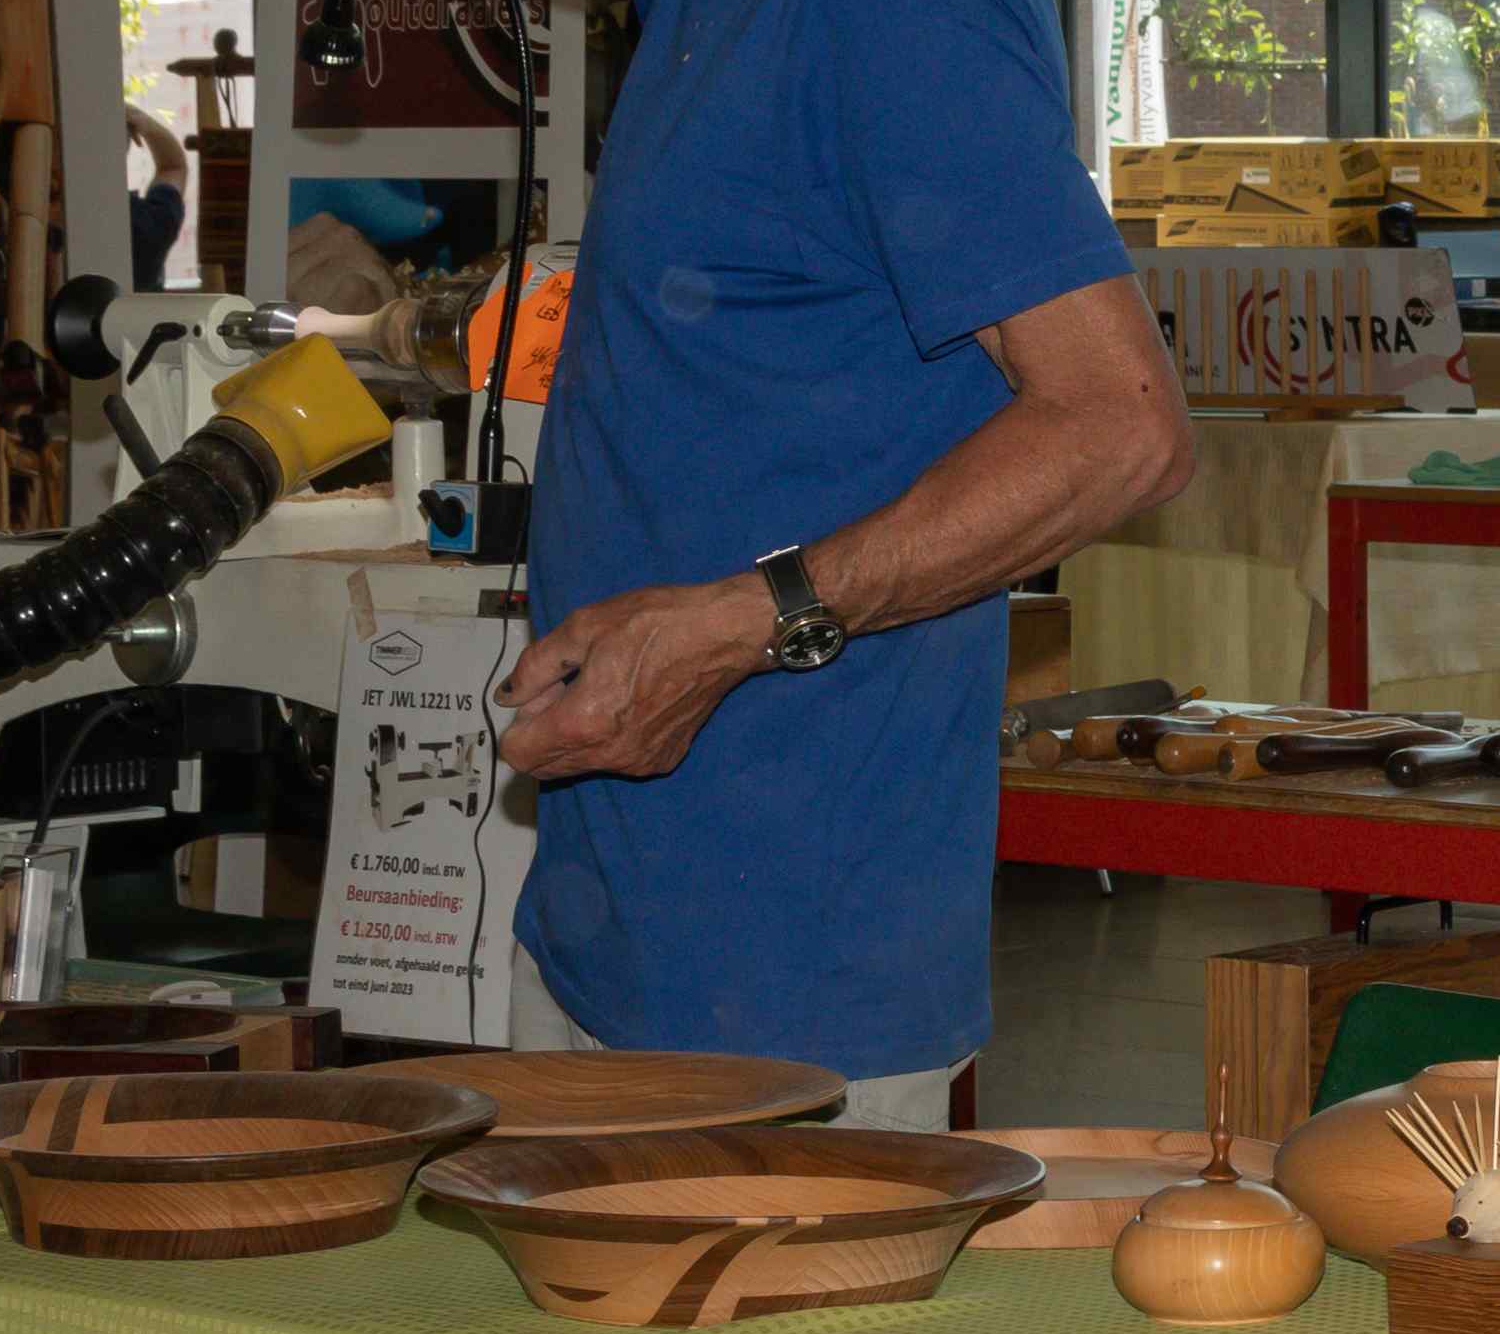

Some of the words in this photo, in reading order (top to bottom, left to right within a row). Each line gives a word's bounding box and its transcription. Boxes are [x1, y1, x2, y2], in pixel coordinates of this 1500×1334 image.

[361, 689, 383, 708] JET
[388, 690, 416, 709] JWL
[419, 692, 451, 710] 1221
[455, 694, 473, 711] VS
[350, 853, 359, 870] €
[363, 855, 420, 877] 1.760,00
[422, 863, 442, 876] incl.
[444, 865, 466, 878] BTW
[341, 920, 350, 936] €
[353, 921, 412, 942] 1.250,00
[414, 930, 433, 943] incl.
[435, 932, 458, 946] BTW
[336, 954, 367, 966] zonder
[370, 957, 391, 970] voet,
[395, 958, 441, 975] afgehaald
[442, 963, 454, 973] en
[333, 978, 347, 989] tot
[348, 979, 368, 991] eind
[370, 981, 389, 994] juni
[391, 982, 414, 995] 2023
